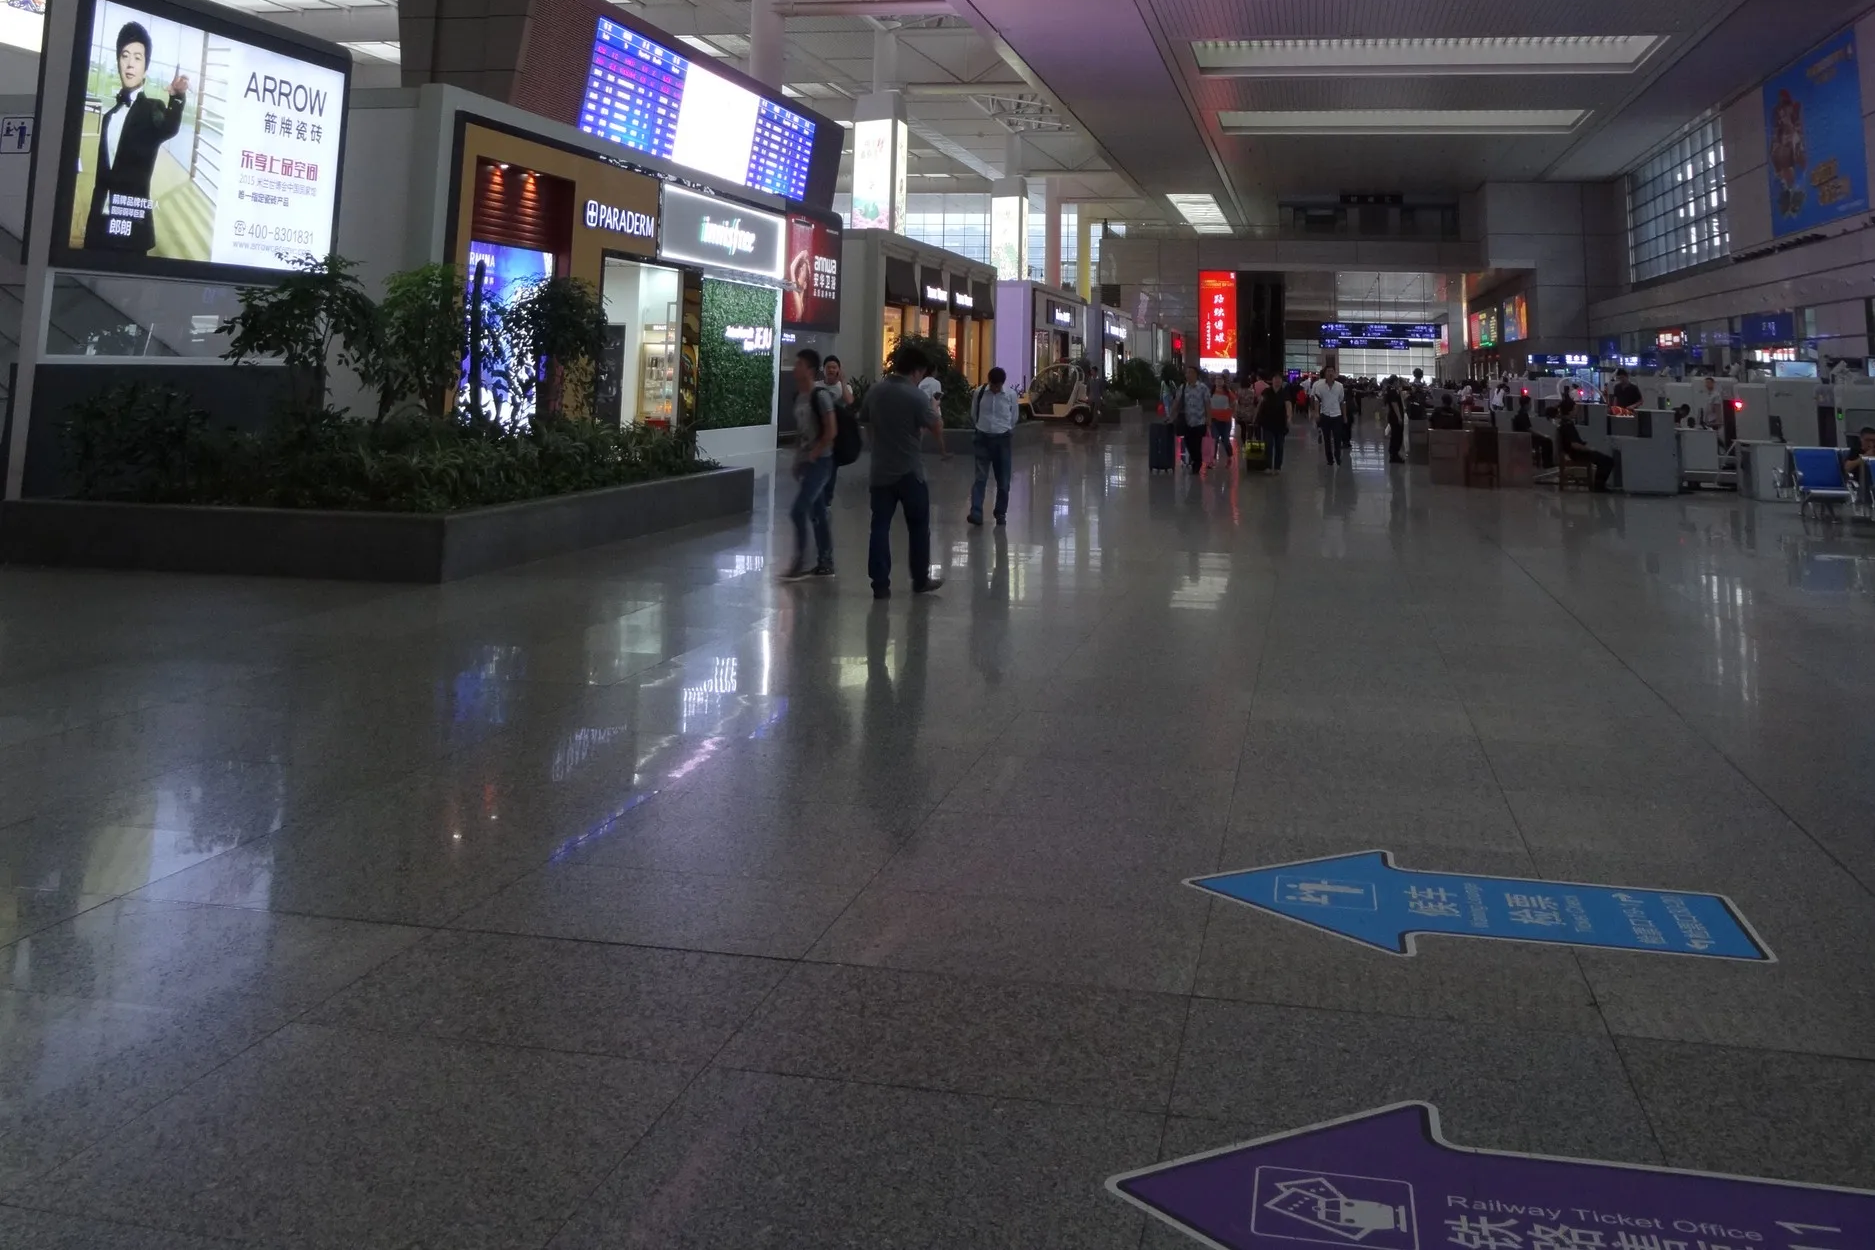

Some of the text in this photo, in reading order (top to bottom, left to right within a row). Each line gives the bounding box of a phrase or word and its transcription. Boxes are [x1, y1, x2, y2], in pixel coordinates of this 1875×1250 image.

[244, 71, 327, 117] ARROW
[264, 112, 322, 144] 箭牌瓷砖
[241, 150, 318, 182] 乐享上品空间
[109, 218, 132, 236] 郎朗
[248, 224, 314, 245] 400-8301831
[599, 208, 655, 238] PARADERM
[1404, 885, 1461, 918] 候车
[1504, 893, 1567, 927] 检票
[1447, 1195, 1764, 1241] Railway Ticket Office
